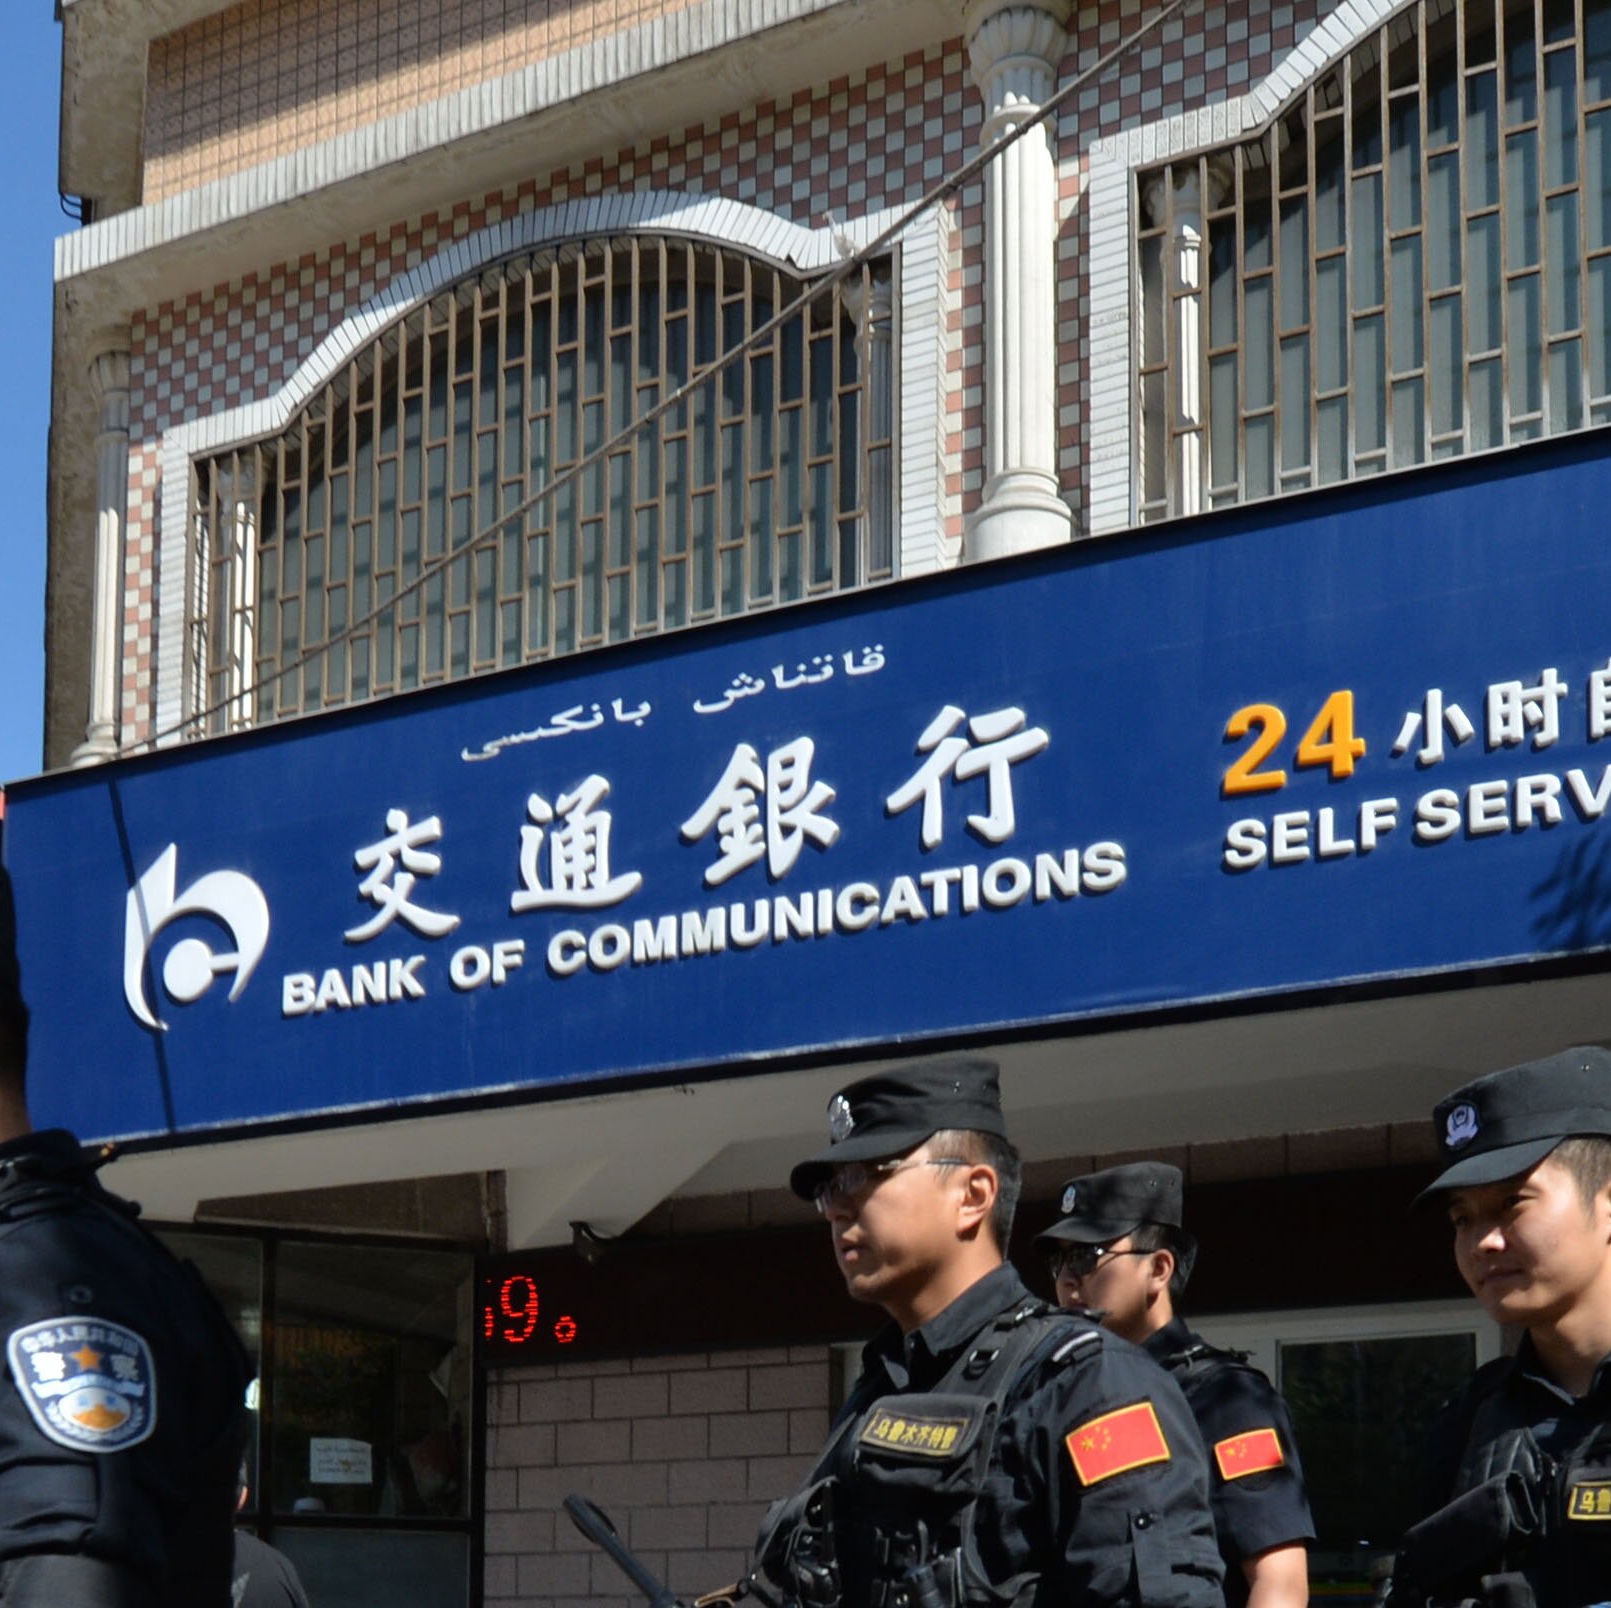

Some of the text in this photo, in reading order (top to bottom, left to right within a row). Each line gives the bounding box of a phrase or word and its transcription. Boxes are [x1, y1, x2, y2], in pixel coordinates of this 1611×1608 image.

[344, 704, 1050, 940] 交通銀行
[1223, 796, 1397, 869] SELF
[281, 841, 1128, 1015] BANK OF COMMUNICATIONS
